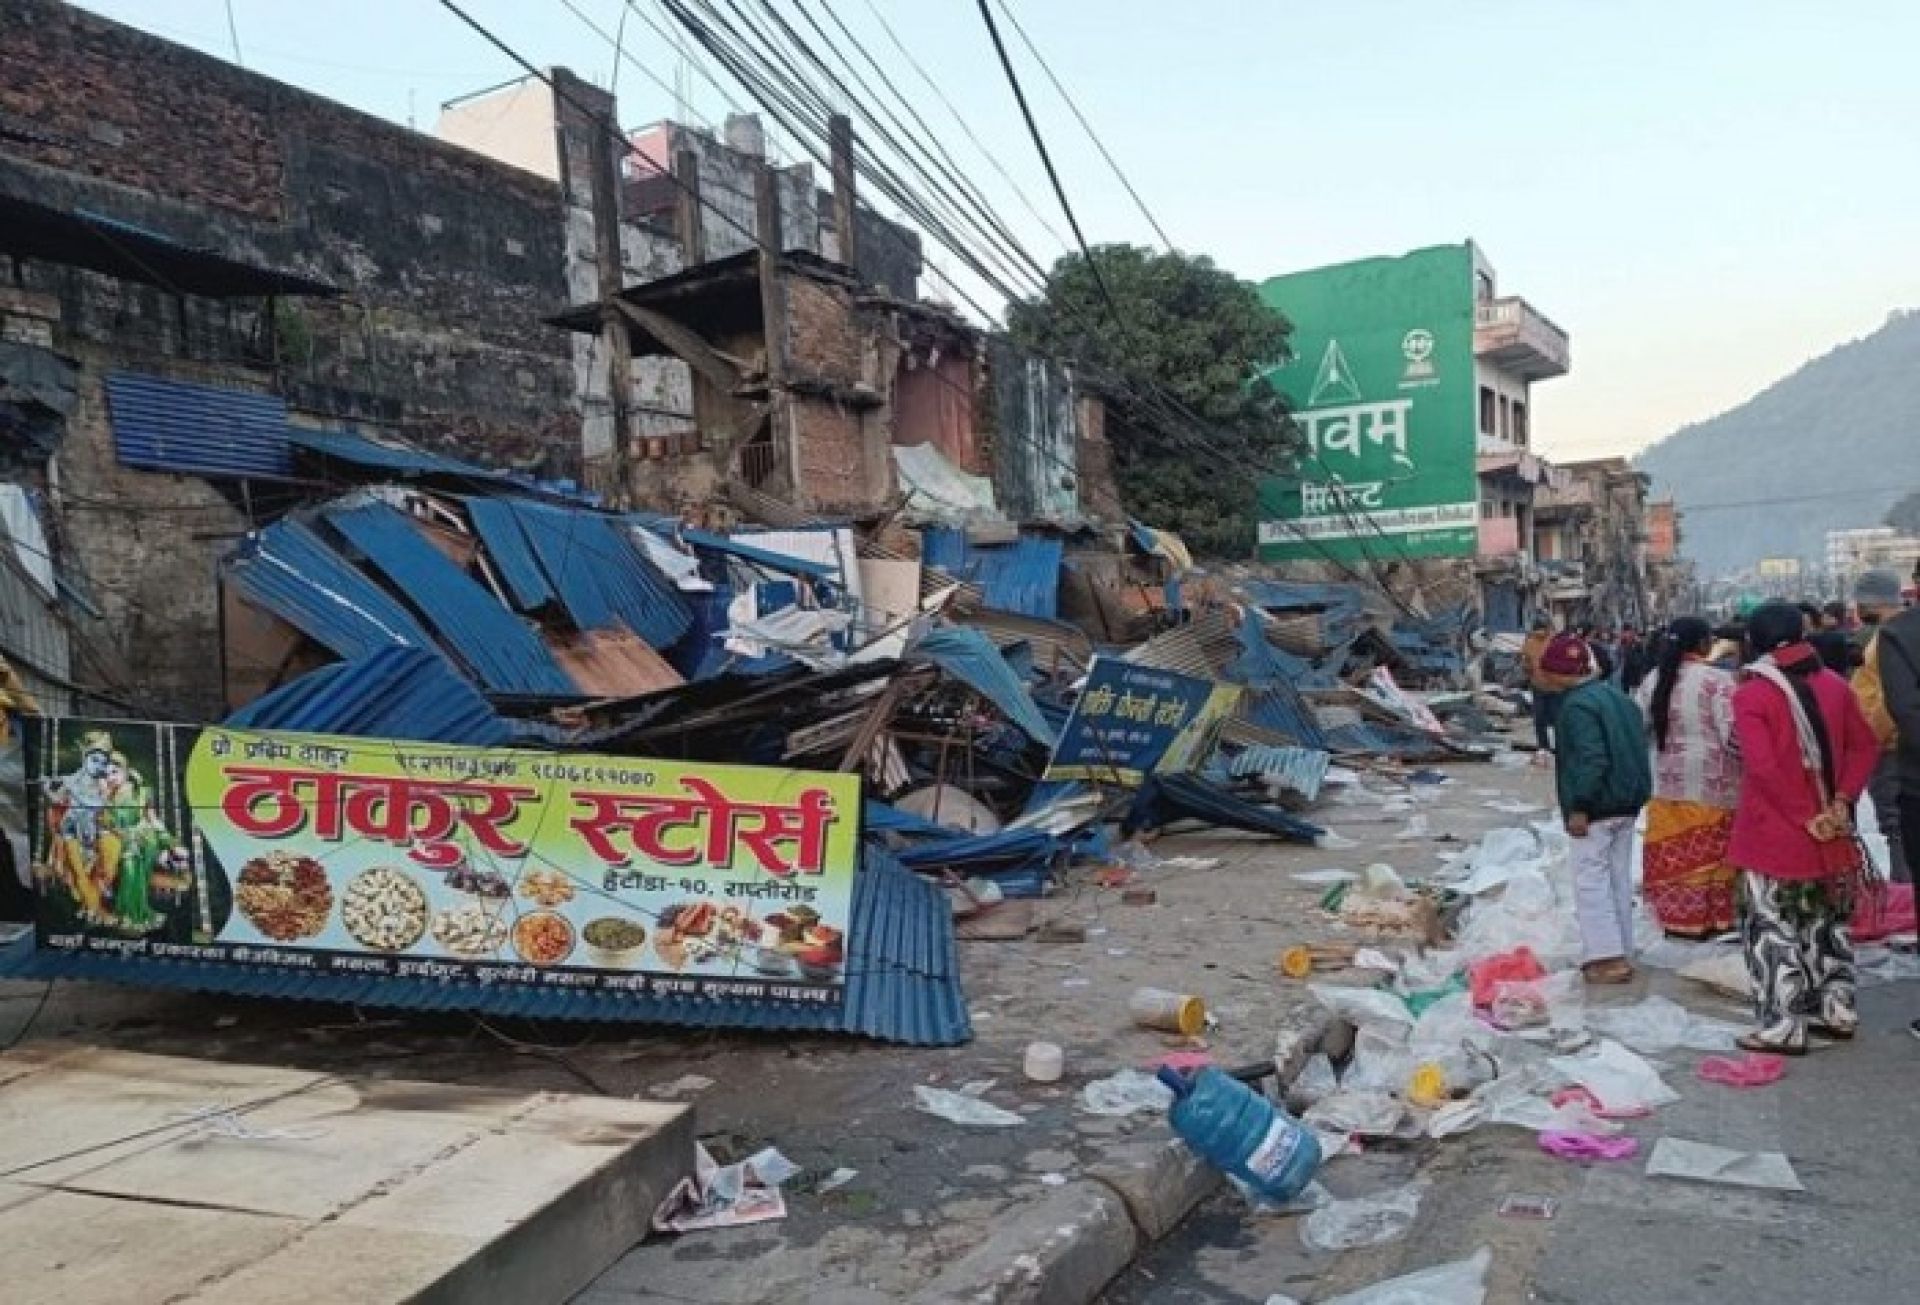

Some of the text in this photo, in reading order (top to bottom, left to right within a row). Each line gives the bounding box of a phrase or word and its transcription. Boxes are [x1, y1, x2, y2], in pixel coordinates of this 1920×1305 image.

[298, 744, 349, 770] ठाकुर
[222, 765, 834, 875] ठाकुर स्टोर्स
